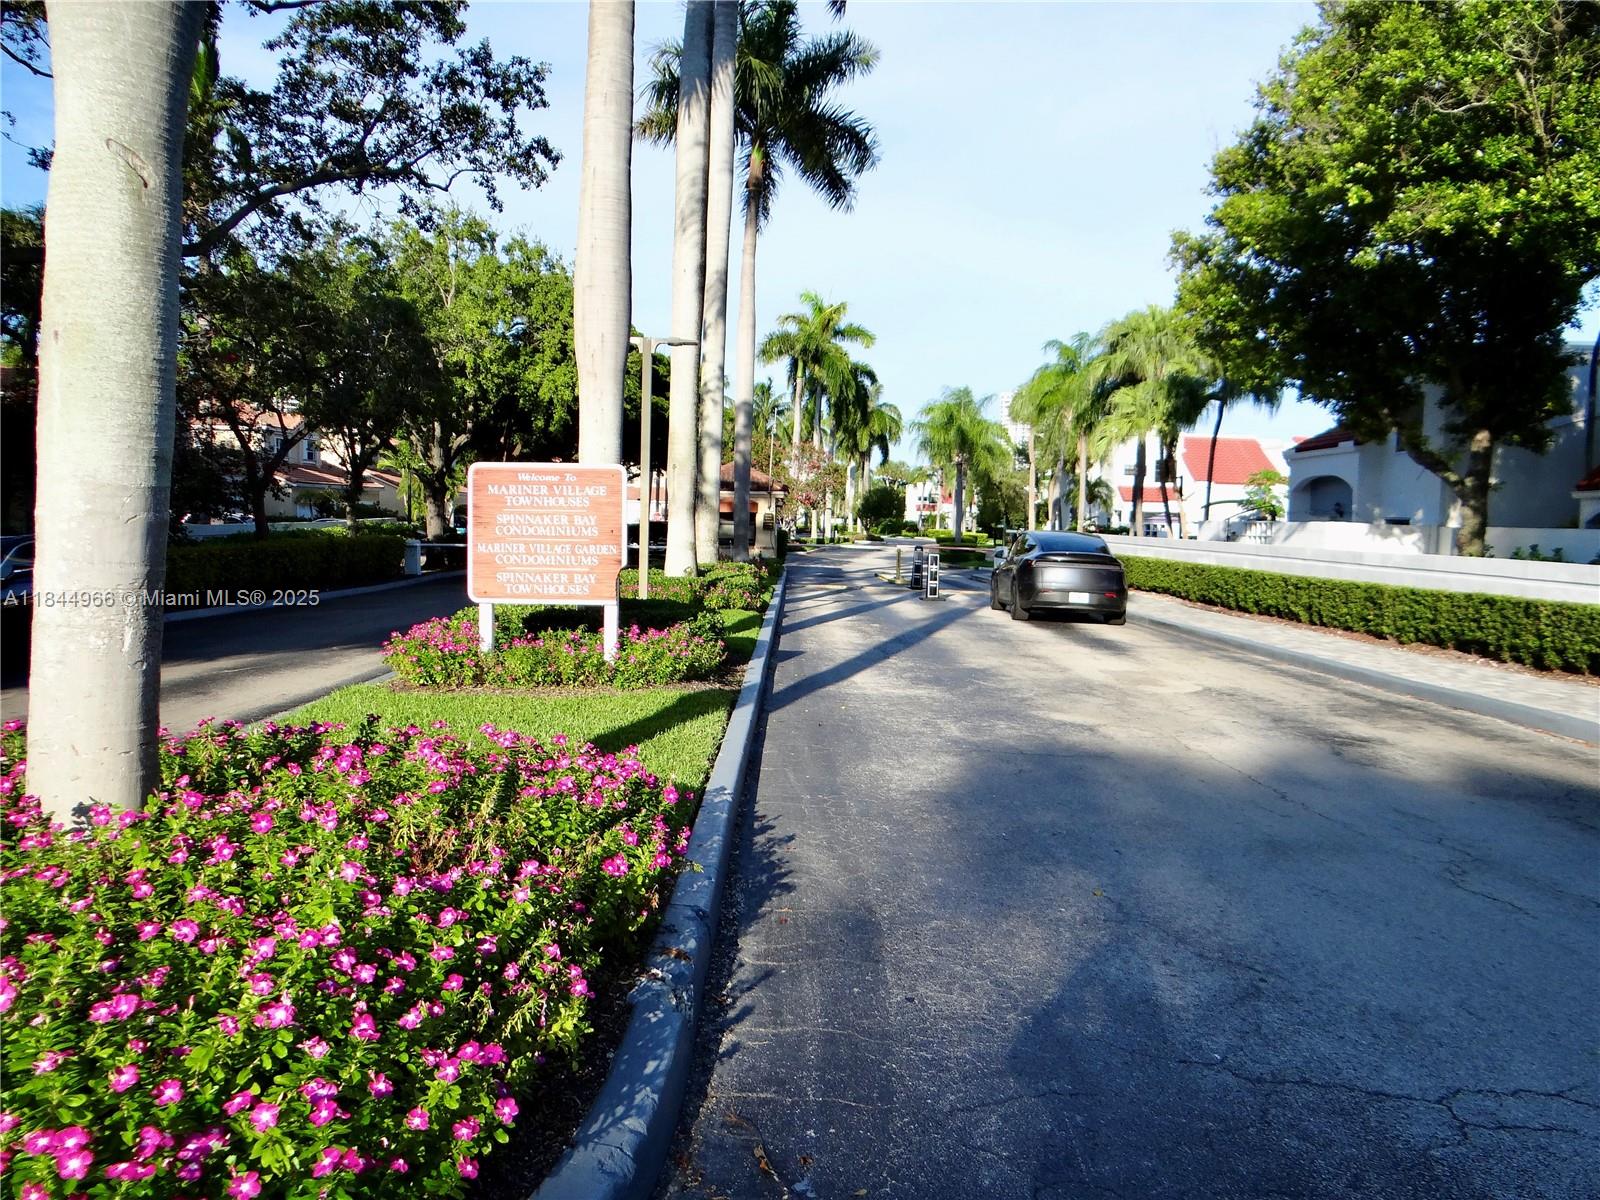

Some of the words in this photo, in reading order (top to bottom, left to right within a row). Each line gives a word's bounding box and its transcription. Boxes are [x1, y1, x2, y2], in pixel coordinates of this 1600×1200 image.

[517, 472, 560, 482] Welcome
[564, 472, 577, 482] To
[488, 484, 548, 495] MARINER
[553, 485, 607, 496] VILLAGE
[504, 496, 590, 507] TOWNHOUSES
[496, 513, 568, 525] SPINNAKER
[574, 514, 597, 526] BAY
[496, 525, 599, 536] CONDOMINIUMS
[477, 543, 526, 553] MARINER
[529, 544, 572, 554] VILLAGE
[574, 544, 616, 555] GARDEN
[496, 554, 599, 566] CONDOMINIUMS
[496, 572, 568, 583] SPINNAKER
[574, 573, 597, 584] BAY
[504, 584, 590, 595] TOWNHOUSES
